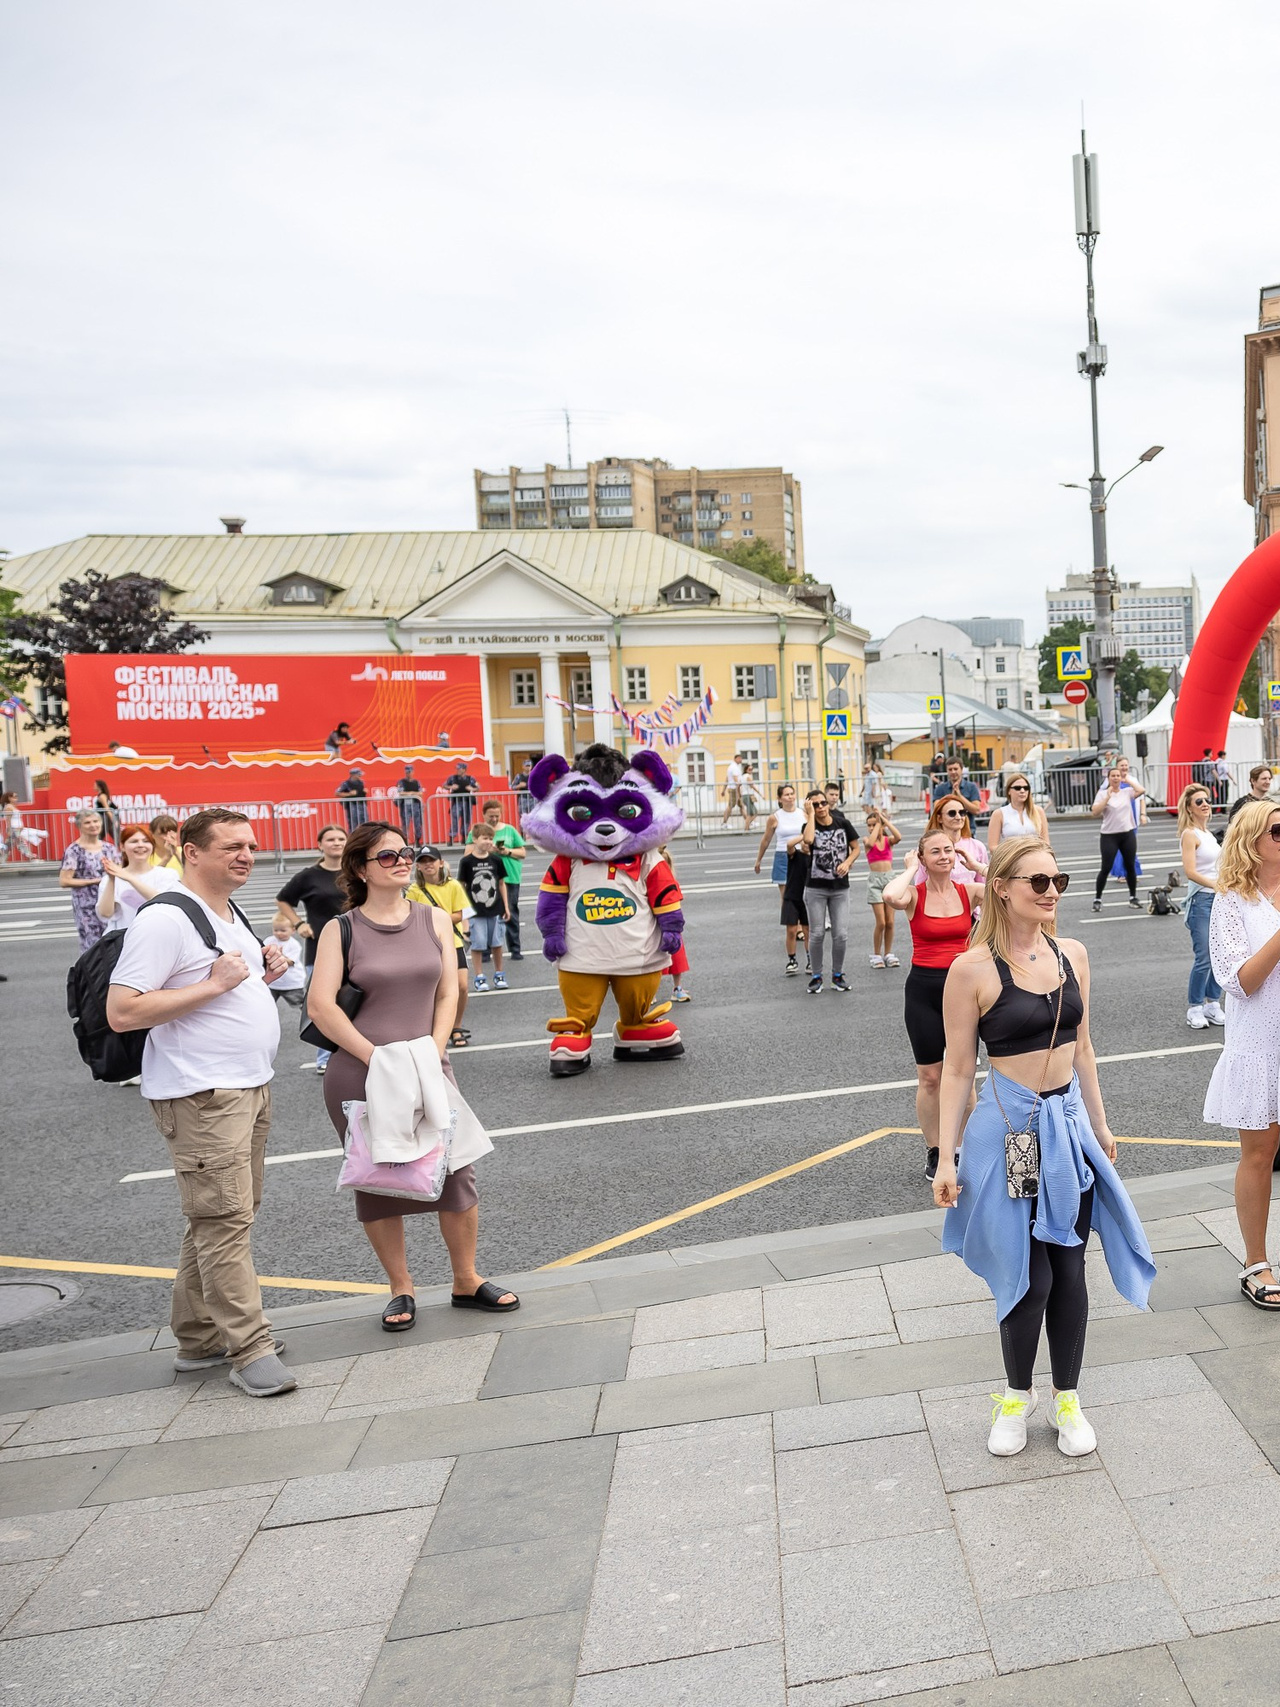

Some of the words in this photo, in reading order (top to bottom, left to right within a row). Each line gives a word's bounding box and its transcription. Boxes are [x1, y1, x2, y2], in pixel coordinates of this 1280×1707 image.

[554, 635, 561, 643] В
[566, 634, 605, 642] МОСКВЕ
[114, 666, 238, 685] ФЕСТИВАЛЬ
[117, 683, 279, 702] «ОЛИМПИЙСКАЯ
[117, 701, 203, 720] МОСКВА
[207, 701, 266, 719] 2025»
[585, 905, 634, 922] ШОНЯ
